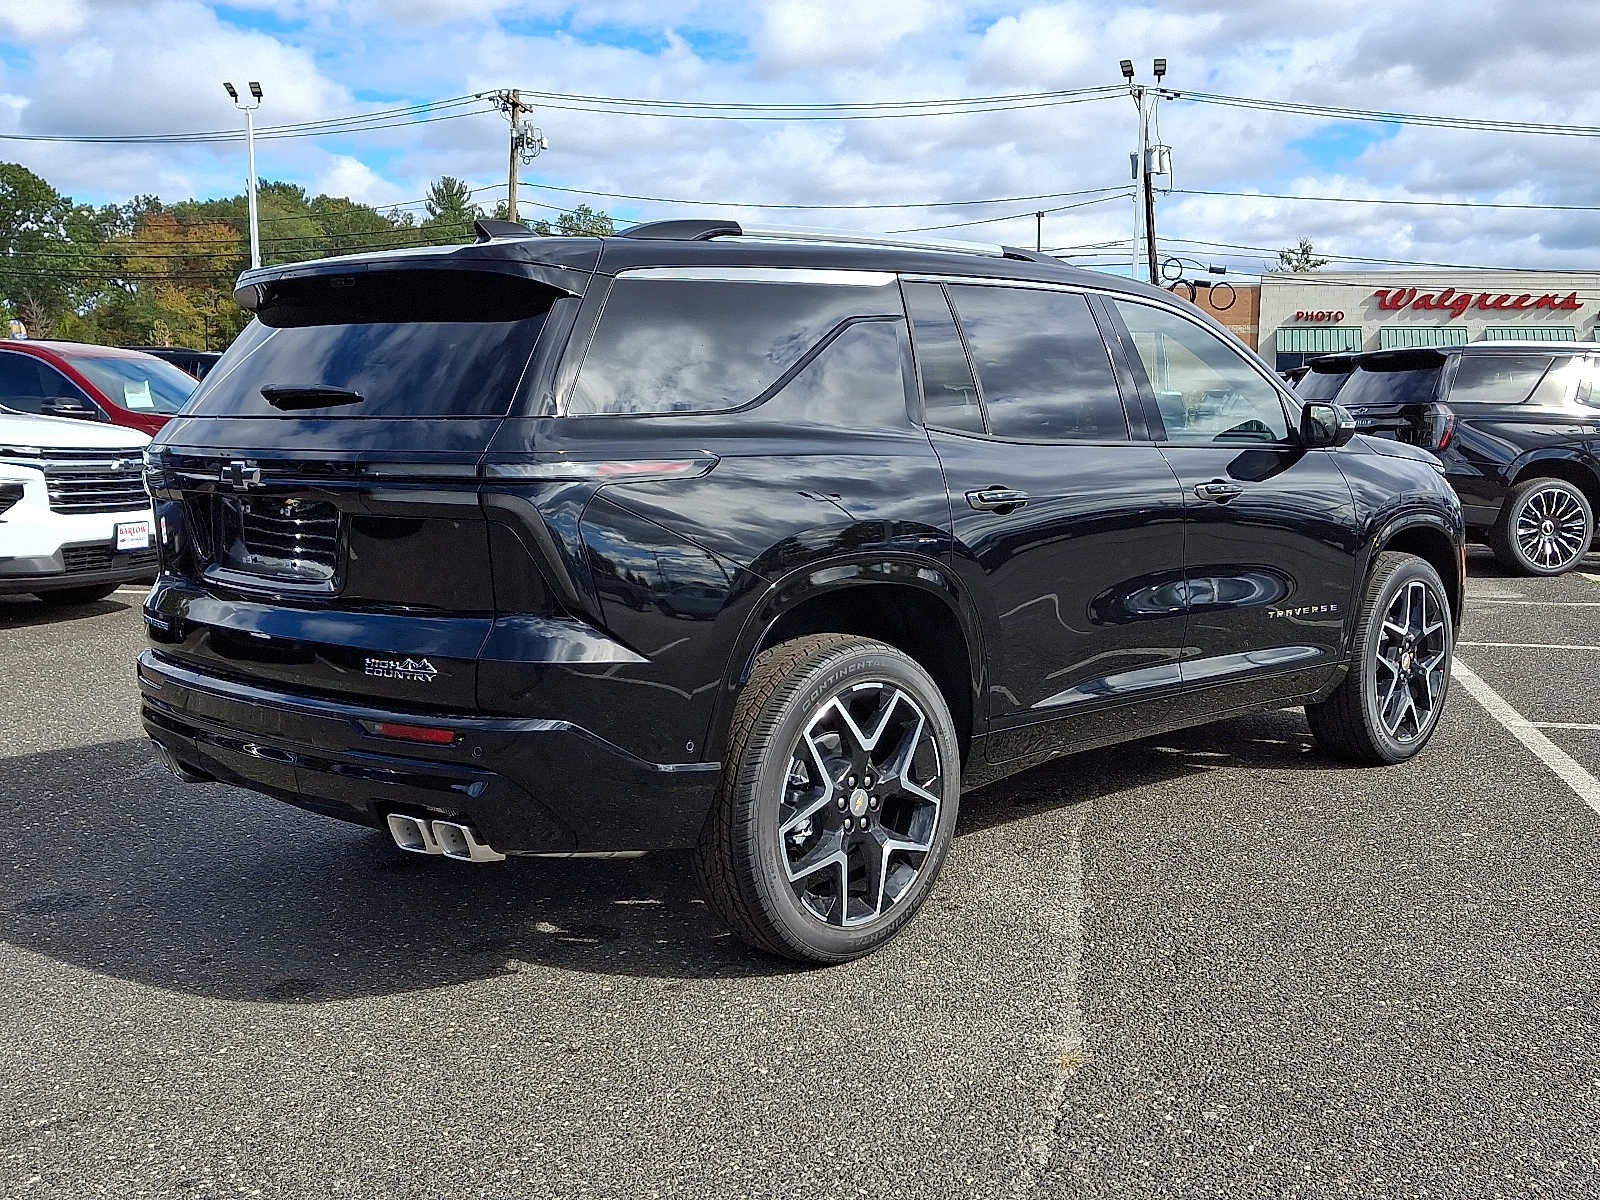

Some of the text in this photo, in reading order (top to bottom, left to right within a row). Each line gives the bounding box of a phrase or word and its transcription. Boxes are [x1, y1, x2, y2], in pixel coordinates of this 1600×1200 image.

[1374, 287, 1585, 319] Walgreens
[1295, 310, 1346, 322] PHOTO
[1267, 603, 1339, 619] TRAVERSE
[364, 658, 401, 669] HIGH
[364, 667, 438, 682] COUNTRY
[802, 659, 886, 713] CONTINENTA
